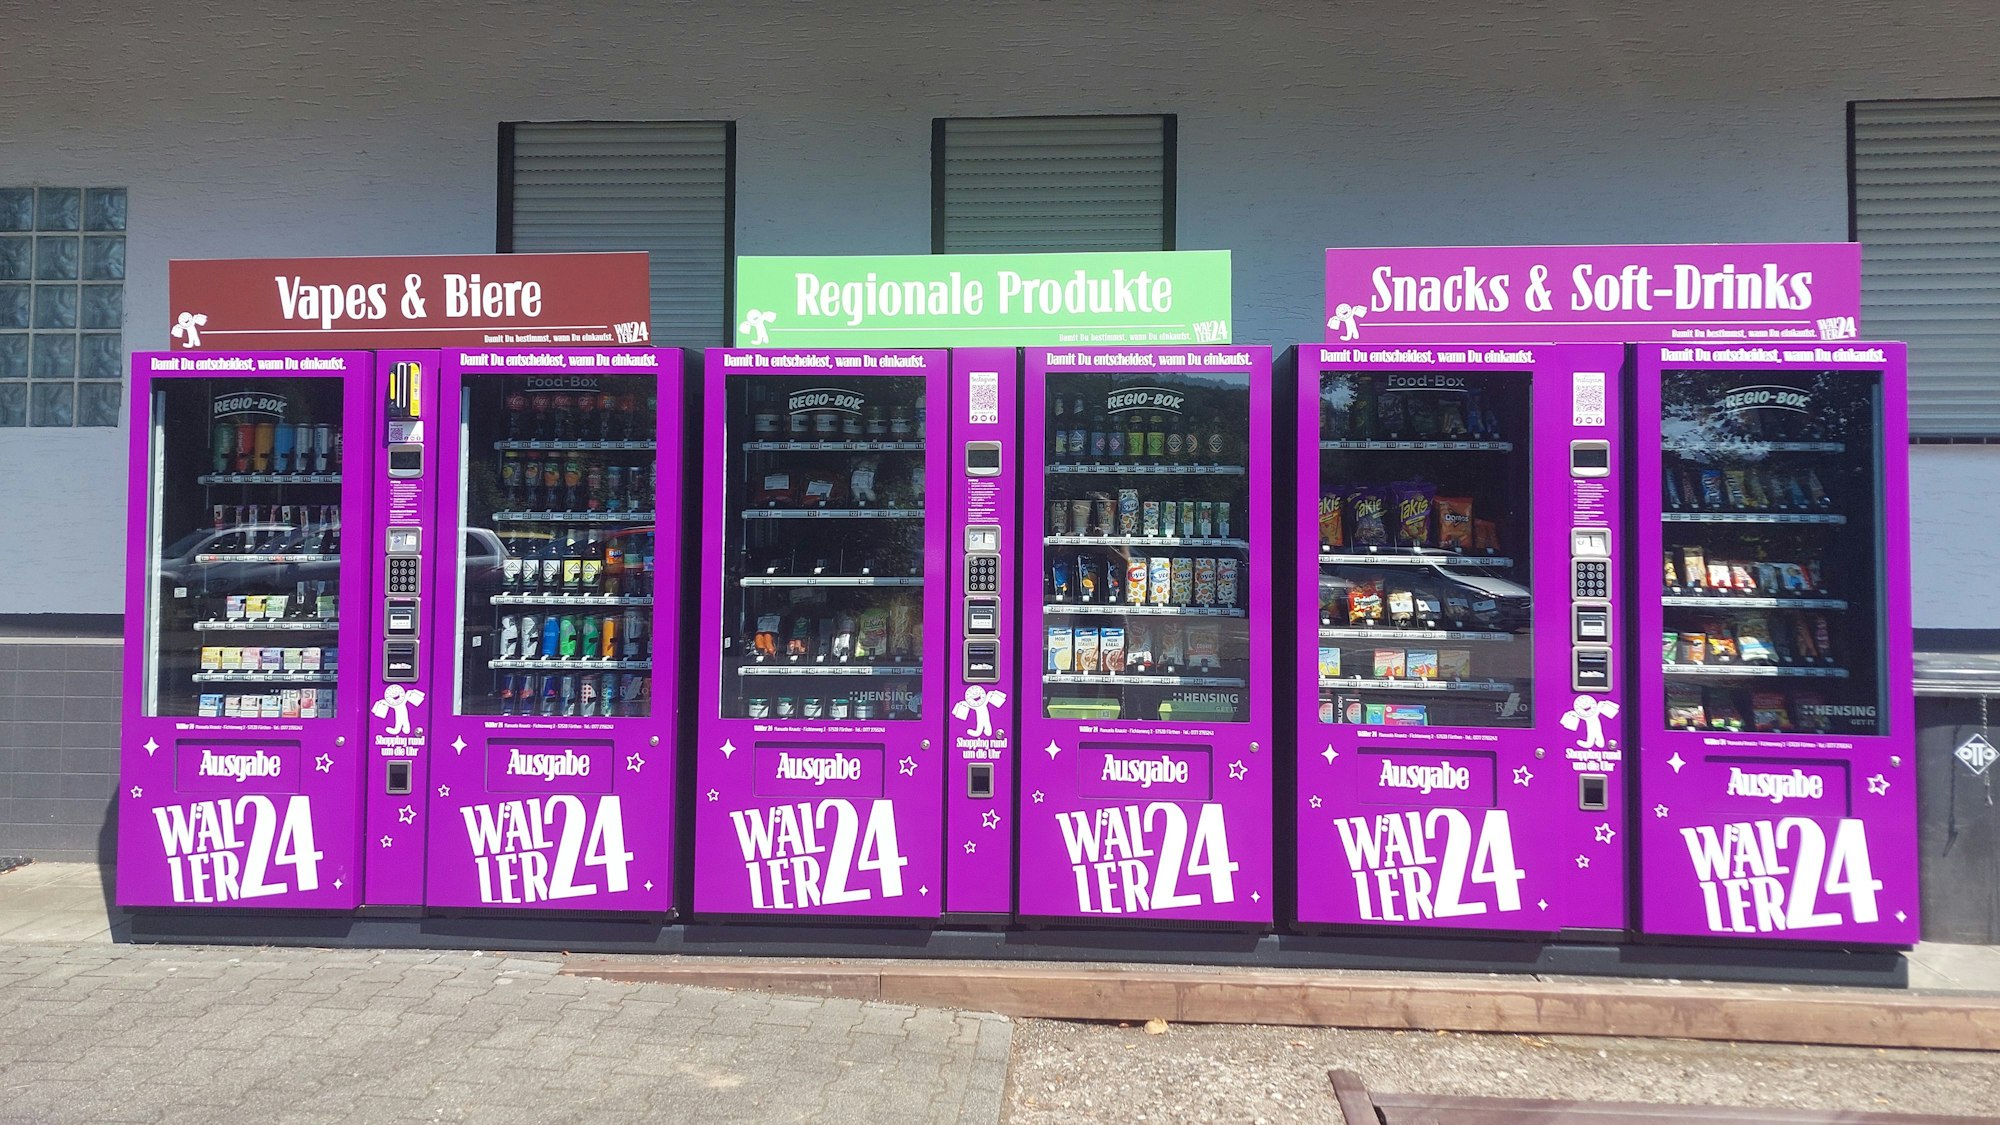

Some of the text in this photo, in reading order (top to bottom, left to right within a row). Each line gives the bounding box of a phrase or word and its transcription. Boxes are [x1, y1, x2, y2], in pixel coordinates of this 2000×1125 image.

[275, 273, 542, 330] Vapes & Biere
[795, 269, 1173, 326] Regionale Produkte
[1371, 263, 1812, 313] Snacks & Soft-Drinks
[632, 321, 649, 342] 24
[1210, 320, 1228, 341] 24
[1837, 316, 1857, 338] 24
[151, 358, 346, 372] Damit Du entscheidest, wann Du einkaufst.
[460, 353, 658, 368] Damit Du entscheidest, wann Du einkaufst.
[724, 354, 926, 369] Damit Du entscheidest, wann Du einkaufst.
[1046, 353, 1252, 368] Damit Du entscheidest, wann Du einkaufst.
[1320, 349, 1535, 365] Damit Du entscheidest, wann Du einkaufst.
[527, 376, 599, 388] Food-Box
[1388, 374, 1465, 388] Food-Box
[1399, 498, 1429, 523] Takis
[1445, 513, 1470, 522] Doritos
[861, 691, 913, 701] HENSING
[1183, 693, 1239, 703] HENSING
[1815, 705, 1876, 717] HENSING
[375, 735, 407, 748] Shopping
[957, 737, 1007, 751] Shopping rund
[199, 750, 281, 782] Ausgabe
[507, 748, 590, 781] Ausgabe
[776, 752, 861, 785] Ausgabe
[1101, 754, 1188, 788] Ausgabe
[1379, 759, 1470, 794] Ausgabe
[1726, 766, 1824, 804] Ausgabe
[235, 795, 323, 899] 24
[543, 794, 634, 900] 24
[815, 798, 908, 905] 24
[1143, 802, 1239, 910] 24
[1424, 808, 1526, 918] 24
[167, 850, 239, 903] LER
[475, 850, 549, 904] LER
[746, 855, 821, 909] LER
[1072, 859, 1150, 913] LER
[1775, 816, 1884, 930] 24
[1352, 866, 1433, 922] LER
[1699, 875, 1786, 933] LER
